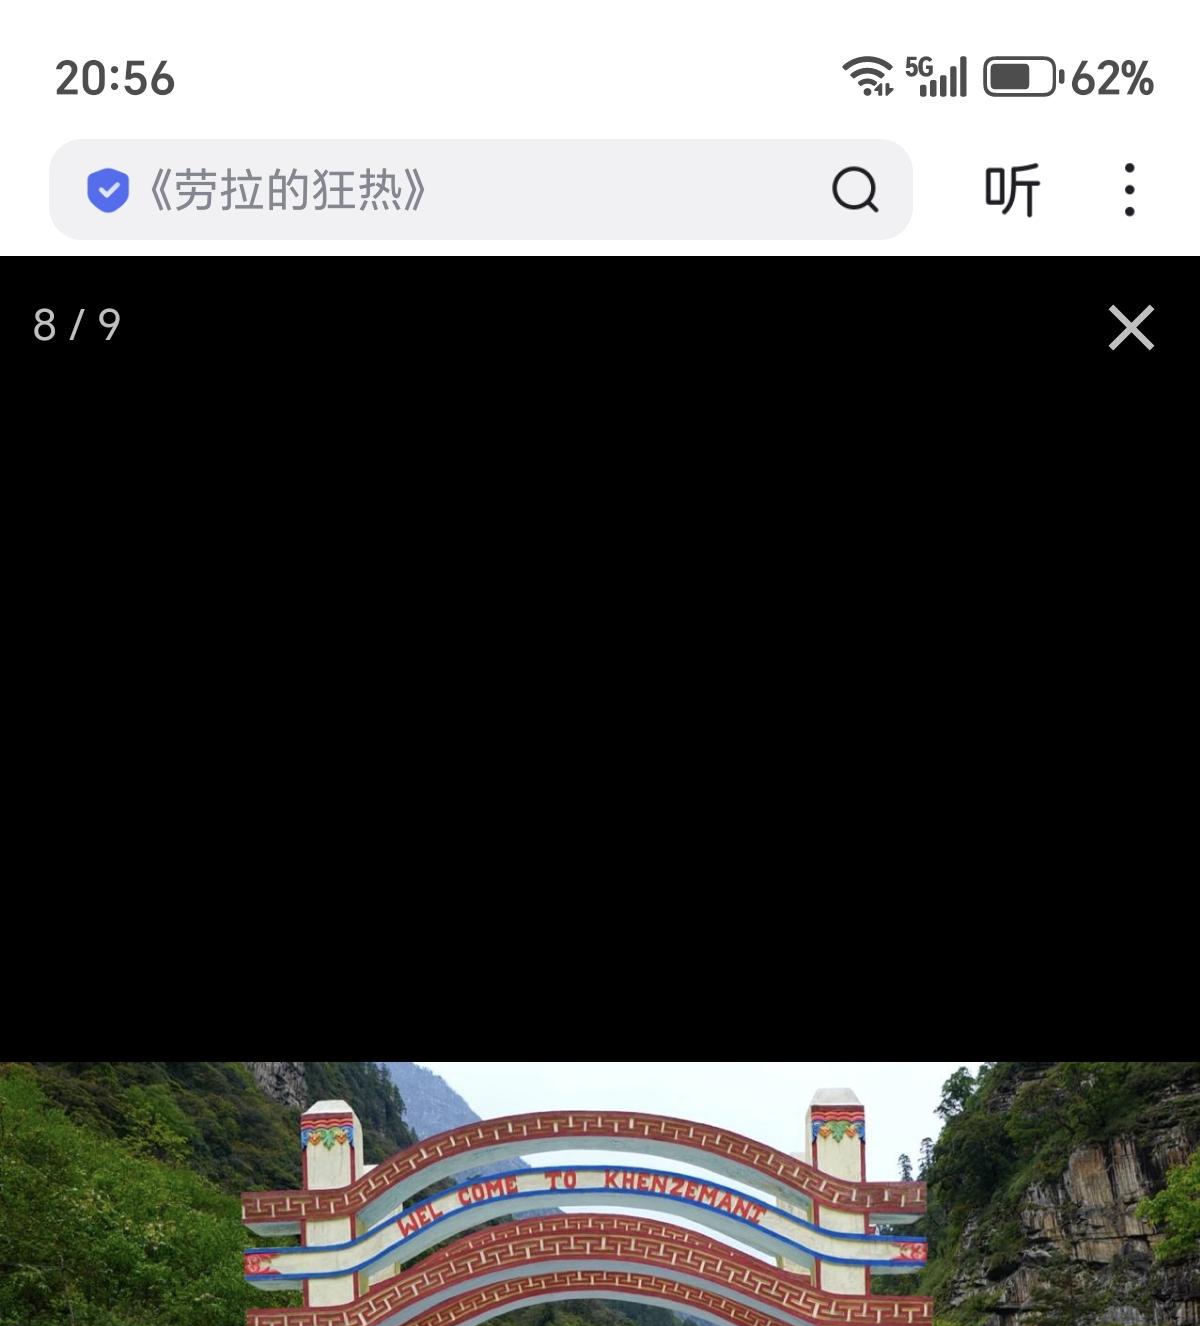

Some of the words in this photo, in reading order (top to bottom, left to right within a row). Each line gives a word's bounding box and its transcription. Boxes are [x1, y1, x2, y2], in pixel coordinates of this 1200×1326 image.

[56, 60, 175, 96] 20:56
[905, 55, 934, 78] 5G
[1071, 60, 1155, 96] 62%
[151, 166, 426, 212] 《劳拉的狂热》
[985, 162, 1041, 219] 听
[397, 1202, 443, 1238] WEL
[456, 1176, 518, 1206] COME
[545, 1170, 577, 1190] TO
